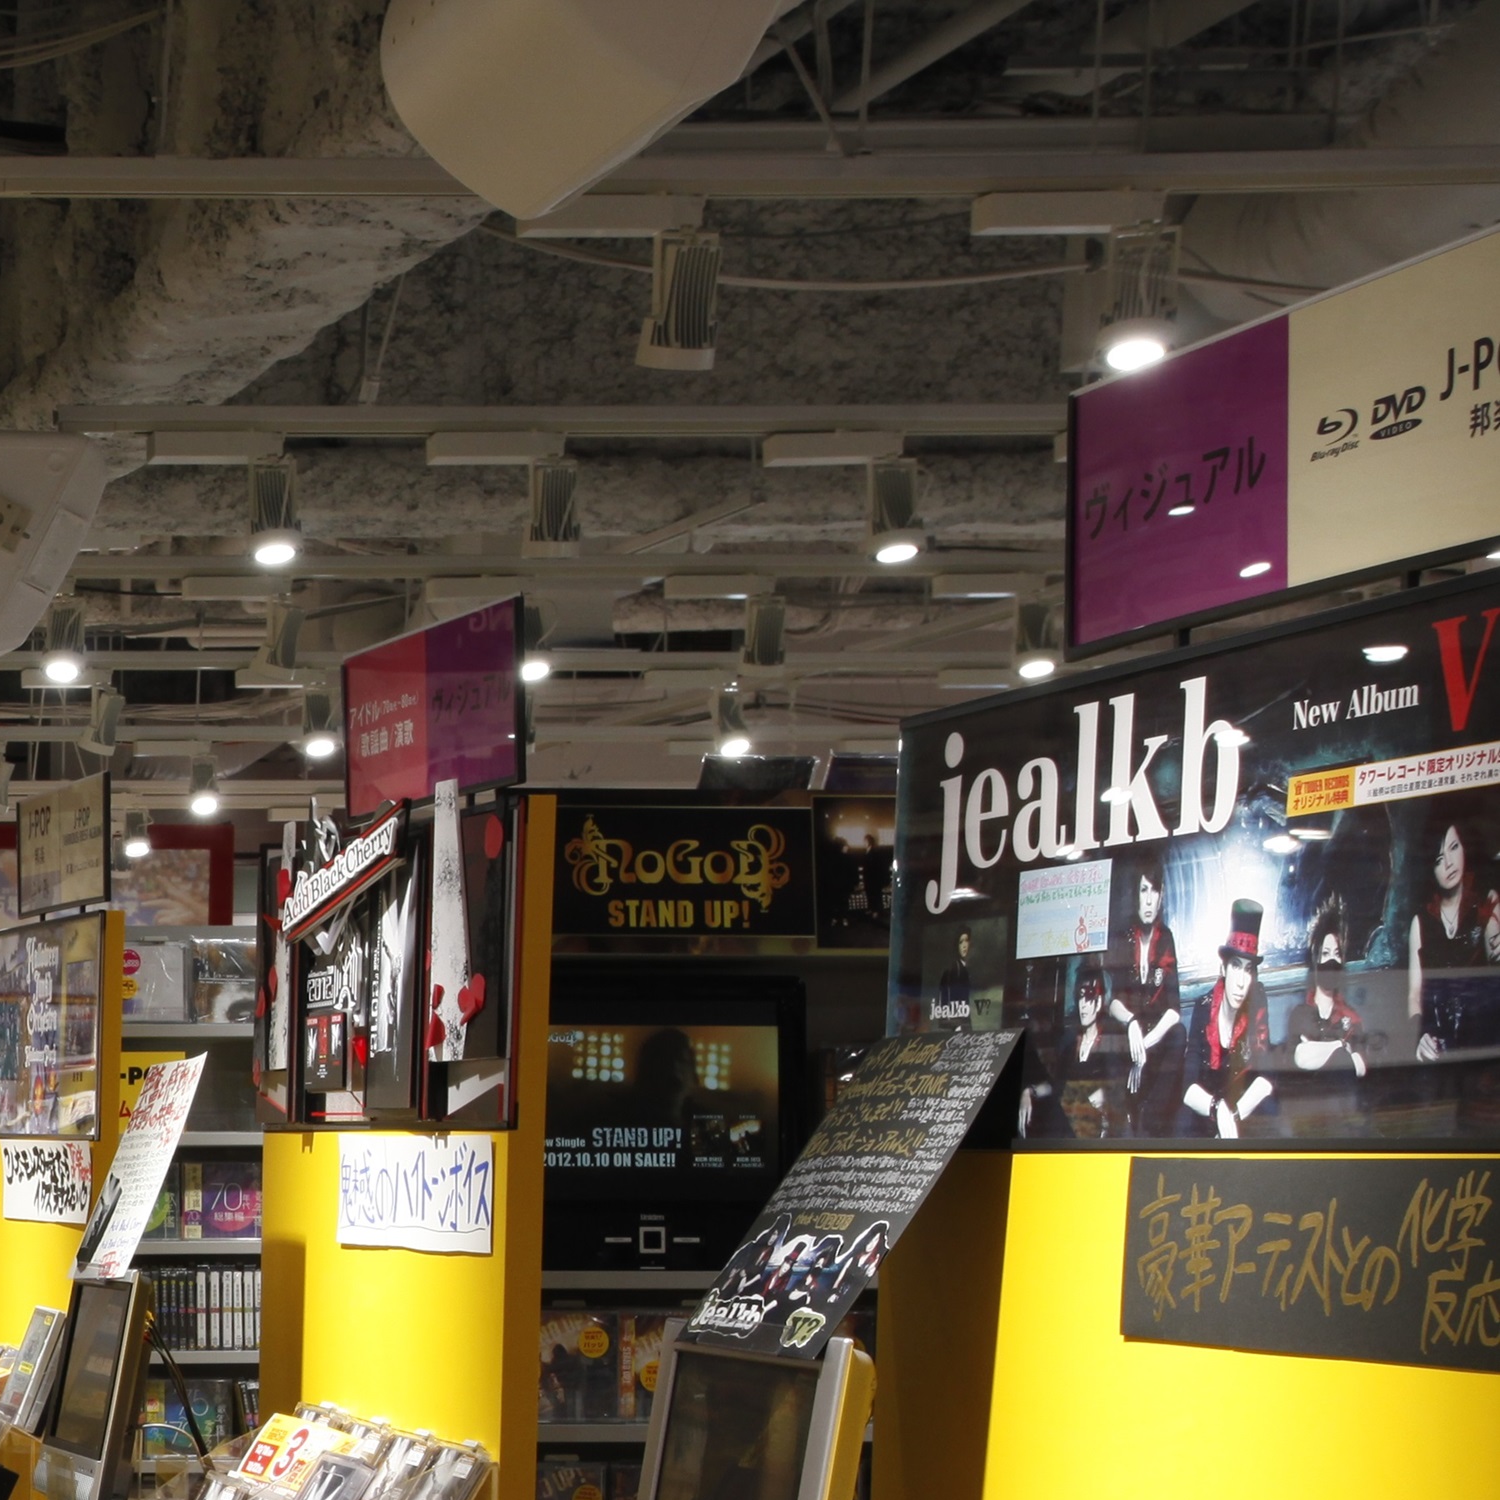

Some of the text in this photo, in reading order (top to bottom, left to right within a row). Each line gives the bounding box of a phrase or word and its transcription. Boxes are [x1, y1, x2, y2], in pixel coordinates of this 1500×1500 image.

[1370, 385, 1426, 426] DVD
[1380, 420, 1414, 437] VIDEO
[1083, 436, 1266, 540] ヴィジュアル
[1292, 683, 1420, 730] New Album
[926, 676, 1242, 915] jealkb
[28, 806, 51, 840] J-POP
[283, 828, 394, 927] Acid Black Cherry
[608, 900, 751, 928] STAND UP!
[930, 1000, 971, 1021] jealkb
[556, 1137, 586, 1149] Single
[592, 1127, 648, 1148] STAND
[653, 1128, 682, 1149] UP!
[613, 1153, 628, 1167] ON
[629, 1153, 676, 1167] SALE!!
[210, 1182, 243, 1212] 70
[1397, 1170, 1493, 1272] 化学
[1137, 1173, 1400, 1323] 豪華アーティストとの
[1421, 1260, 1500, 1355] 反応
[273, 1428, 310, 1477] 3
